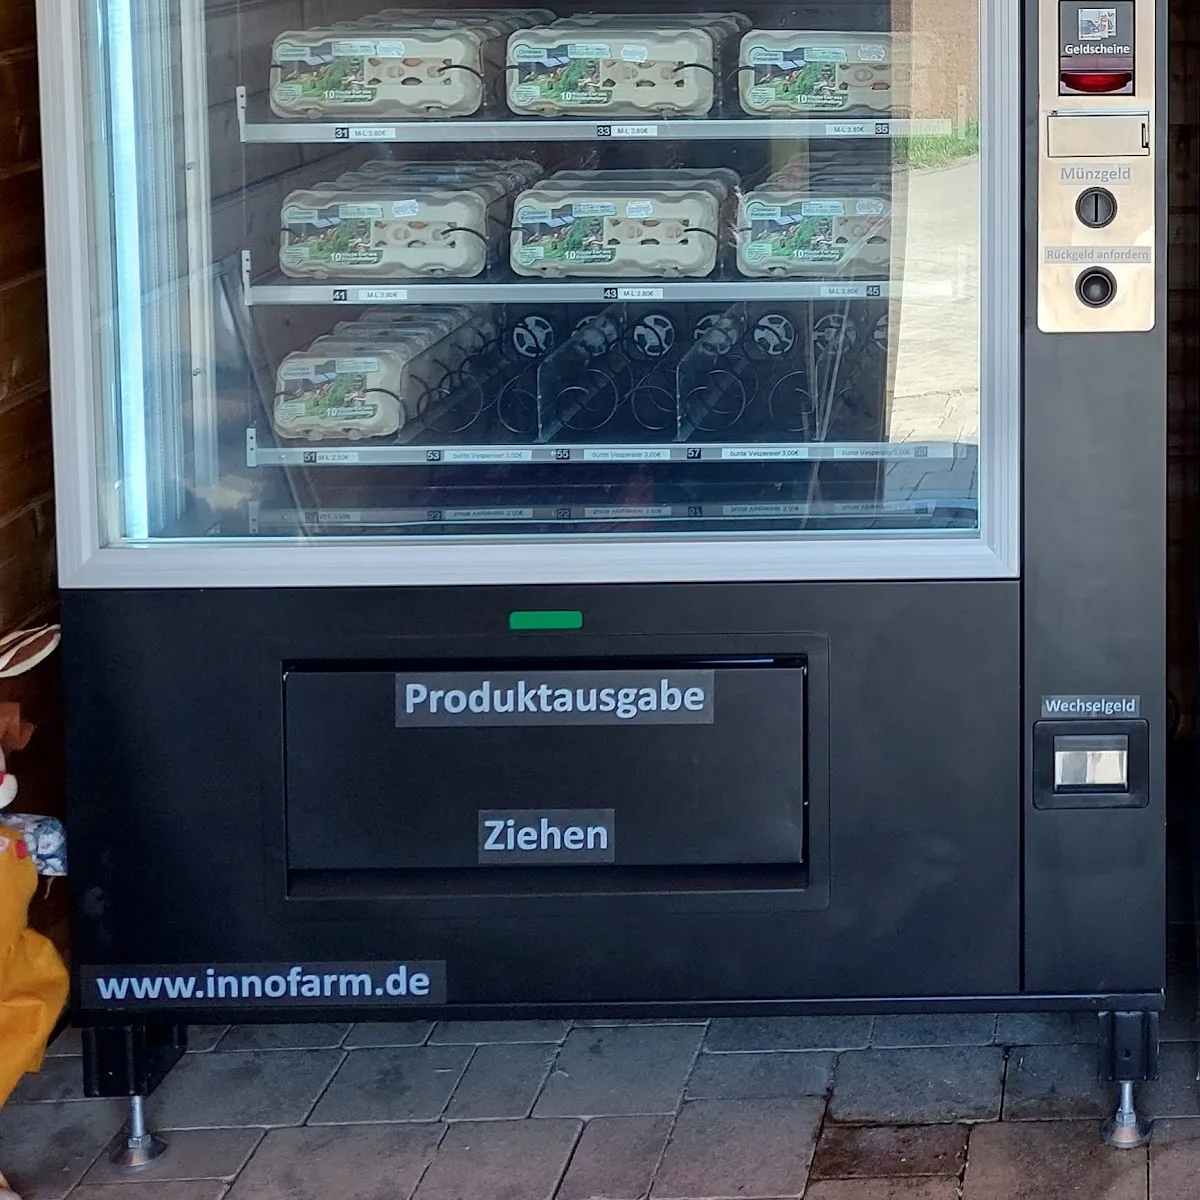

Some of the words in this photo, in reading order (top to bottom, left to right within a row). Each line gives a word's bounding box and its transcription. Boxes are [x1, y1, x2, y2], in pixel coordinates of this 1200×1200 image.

[1065, 44, 1131, 55] Geldscheine
[561, 92, 572, 101] 10
[335, 128, 349, 138] 31
[597, 126, 611, 136] 33
[875, 124, 888, 134] 35
[1061, 167, 1131, 182] Münzgeld
[564, 251, 576, 260] 10
[793, 249, 804, 259] 10
[1047, 250, 1094, 261] Rückgeld
[1096, 250, 1149, 260] anfordern
[333, 290, 346, 300] 41
[604, 289, 617, 298] 43
[867, 286, 879, 296] 45
[304, 452, 317, 462] 51
[426, 451, 440, 460] 53
[556, 450, 569, 459] 55
[687, 448, 701, 458] 57
[405, 679, 705, 719] Produktausgabe
[1045, 698, 1135, 715] Wechselgeld
[483, 819, 608, 851] Ziehen
[97, 966, 431, 1002] www.innofarm.de
